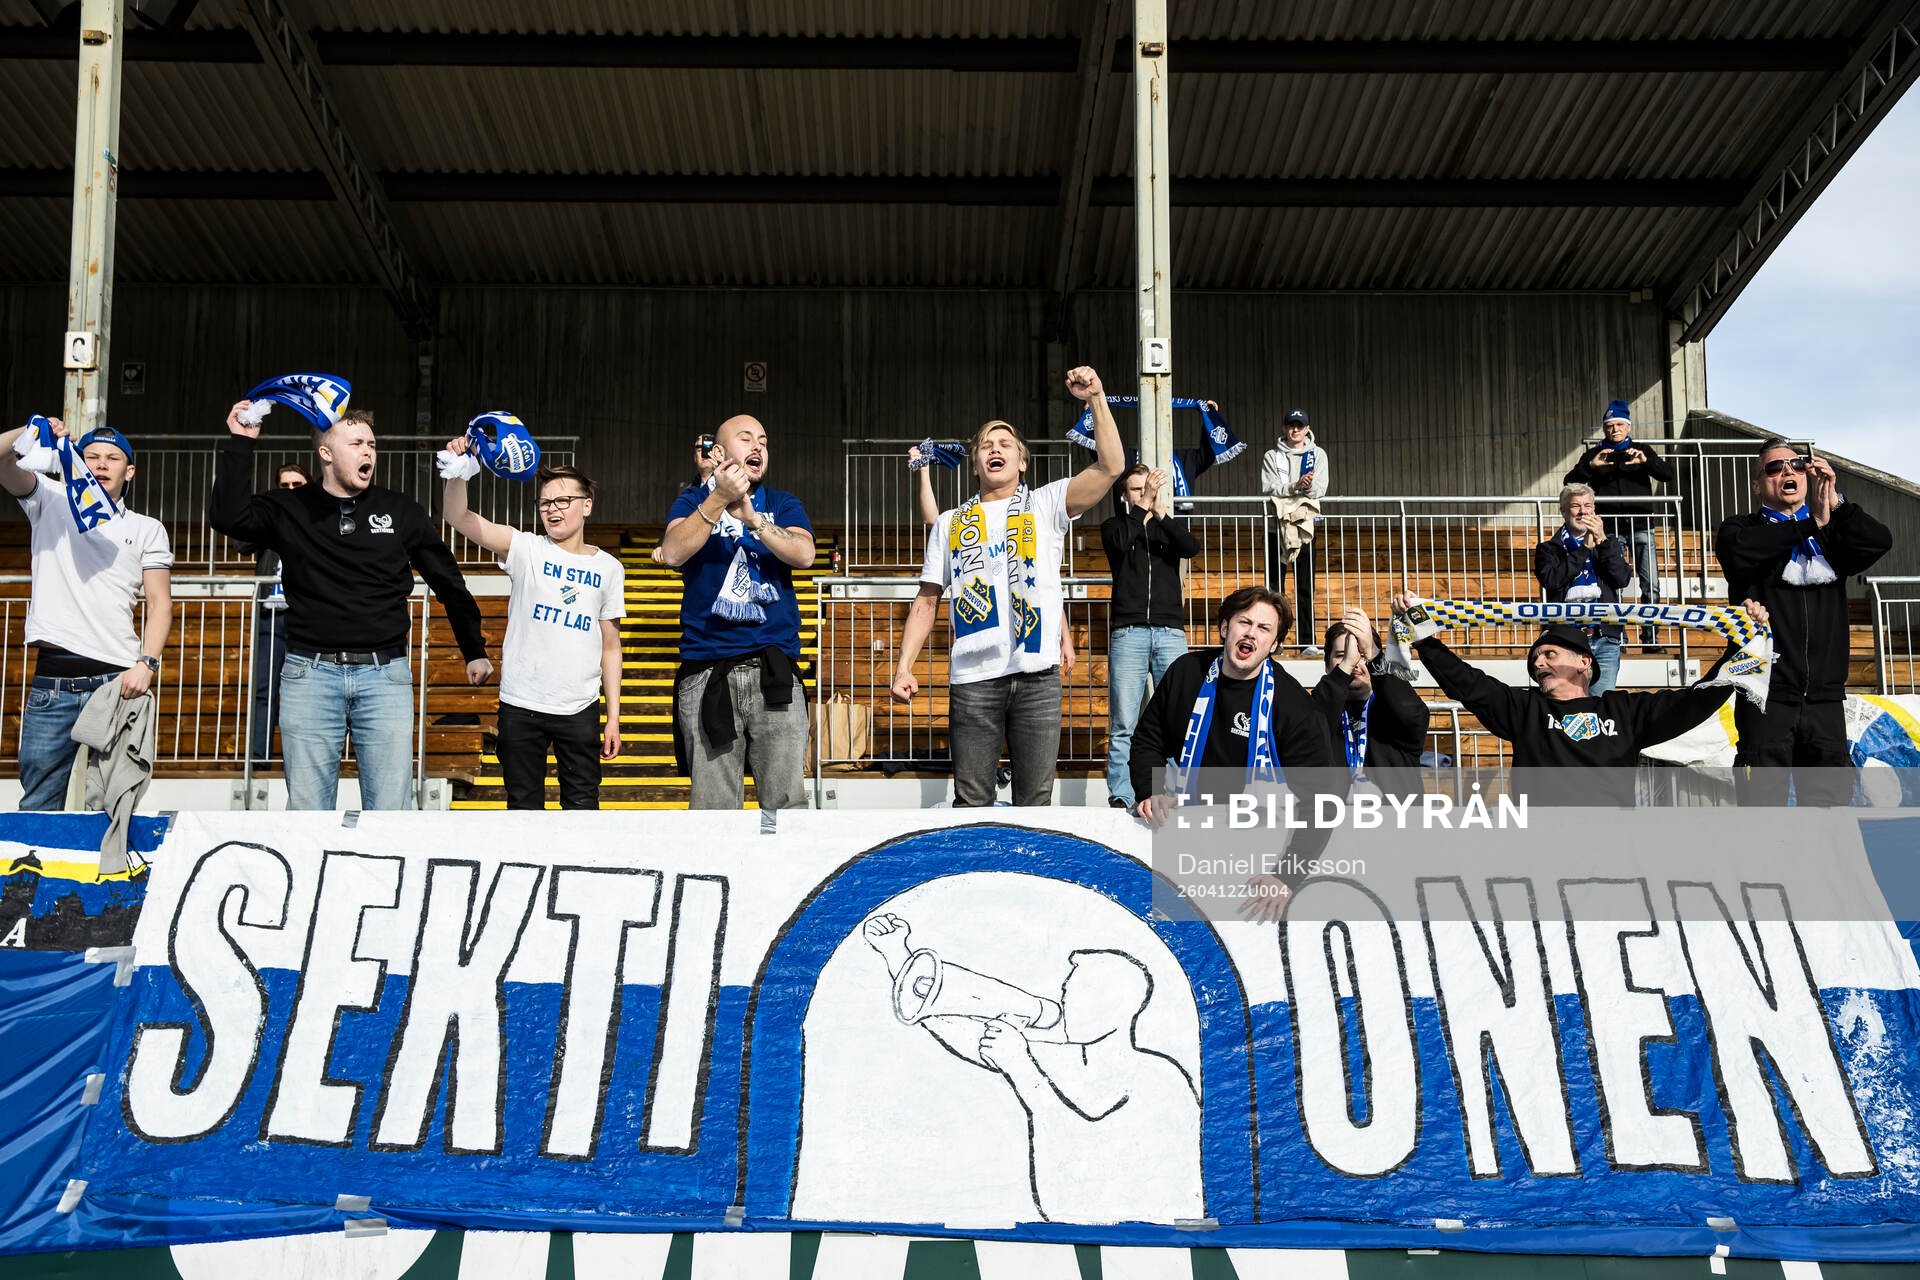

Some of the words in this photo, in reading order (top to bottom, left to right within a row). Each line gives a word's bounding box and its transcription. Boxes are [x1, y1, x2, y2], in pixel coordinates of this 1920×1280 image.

[543, 561, 563, 579] EN
[566, 568, 602, 588] STAD
[962, 585, 988, 613] ODDEVOLD
[533, 603, 562, 624] ETT
[564, 611, 592, 632] LAG
[1517, 604, 1707, 623] ODDEVOLD
